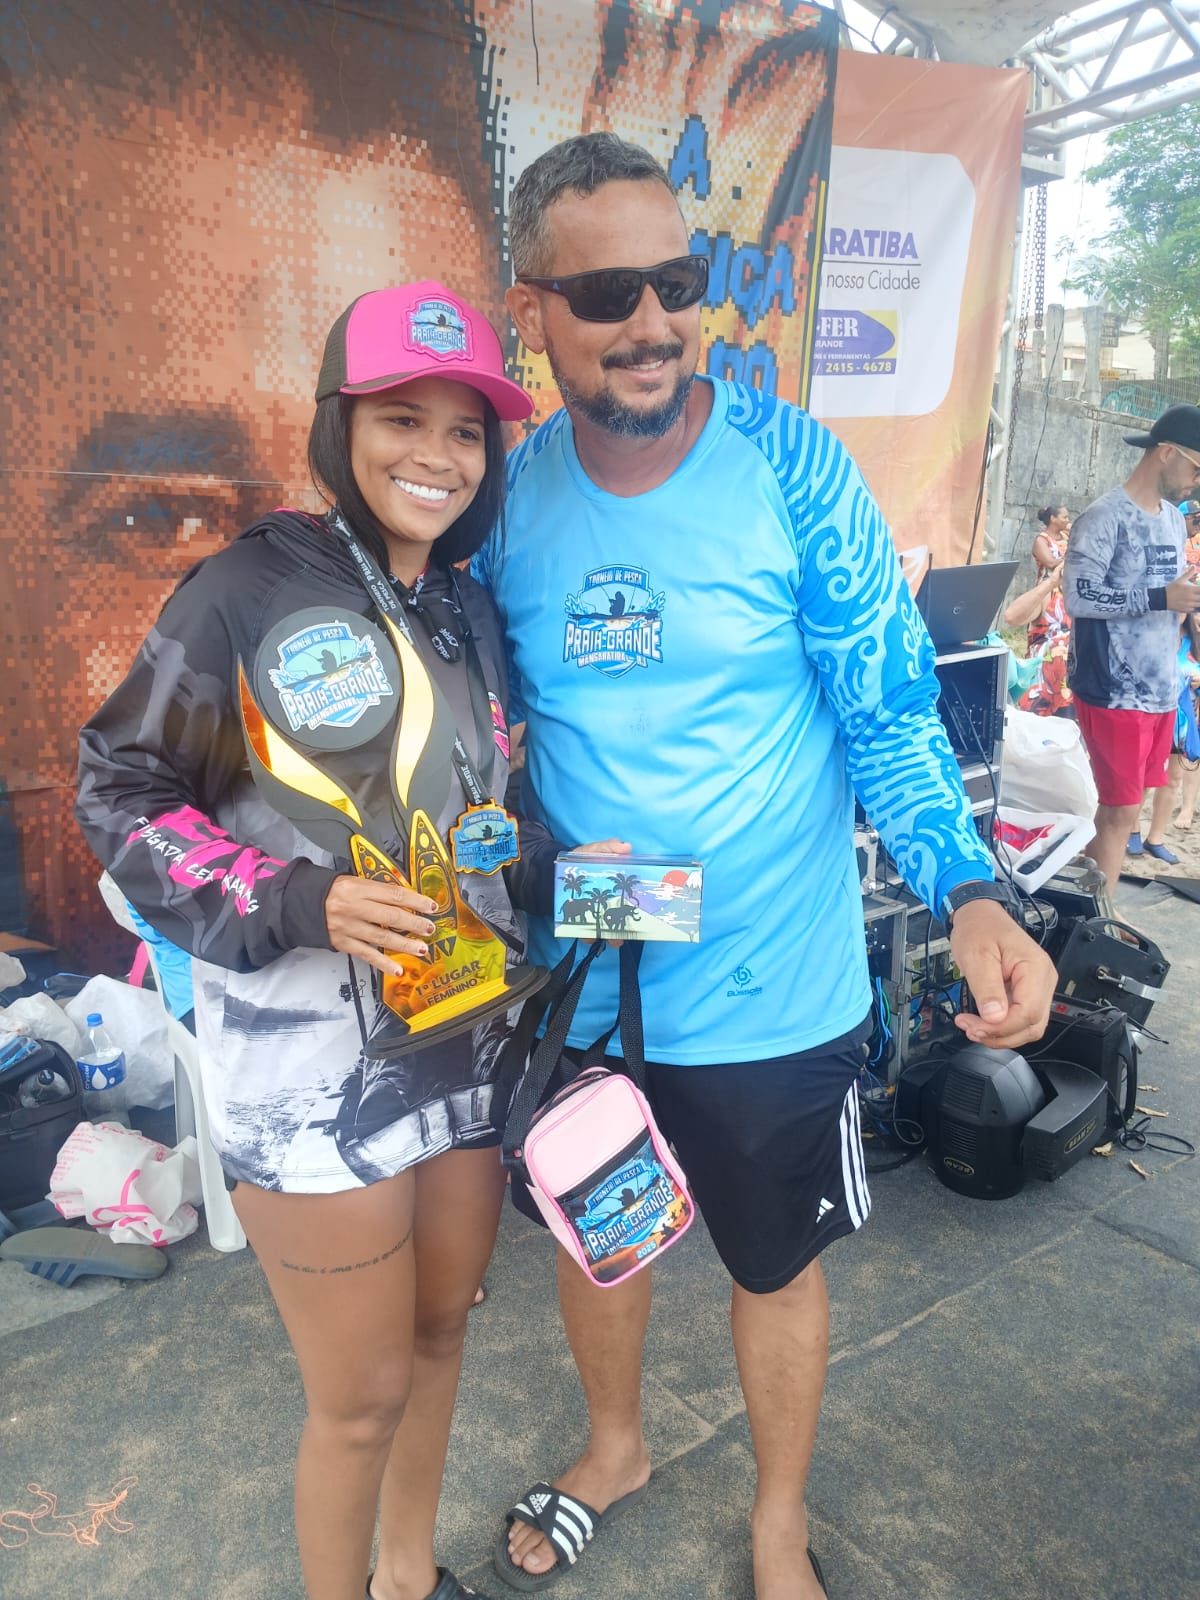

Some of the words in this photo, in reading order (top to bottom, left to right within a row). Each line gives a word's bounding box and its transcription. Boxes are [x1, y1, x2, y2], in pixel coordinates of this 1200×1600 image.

[668, 114, 711, 201] A
[822, 227, 919, 259] RATIBA
[827, 274, 865, 289] nossa
[868, 269, 921, 290] Cidade
[826, 363, 854, 373] 2415
[862, 362, 892, 372] 4678
[371, 584, 390, 612] TORNEIO
[377, 580, 391, 603] PESCA
[563, 620, 602, 662] PRAIA
[606, 620, 663, 662] GRANDE
[281, 687, 329, 730] PRAIA
[330, 661, 392, 702] GRANDE
[133, 816, 186, 866] FISGADA
[431, 960, 482, 988] LUGAR
[427, 978, 478, 1006] FEMININO
[586, 1222, 628, 1259] PRAIA
[628, 1177, 675, 1226] GRANDE
[637, 1241, 657, 1259] 2025
[529, 1494, 543, 1515] adidas
